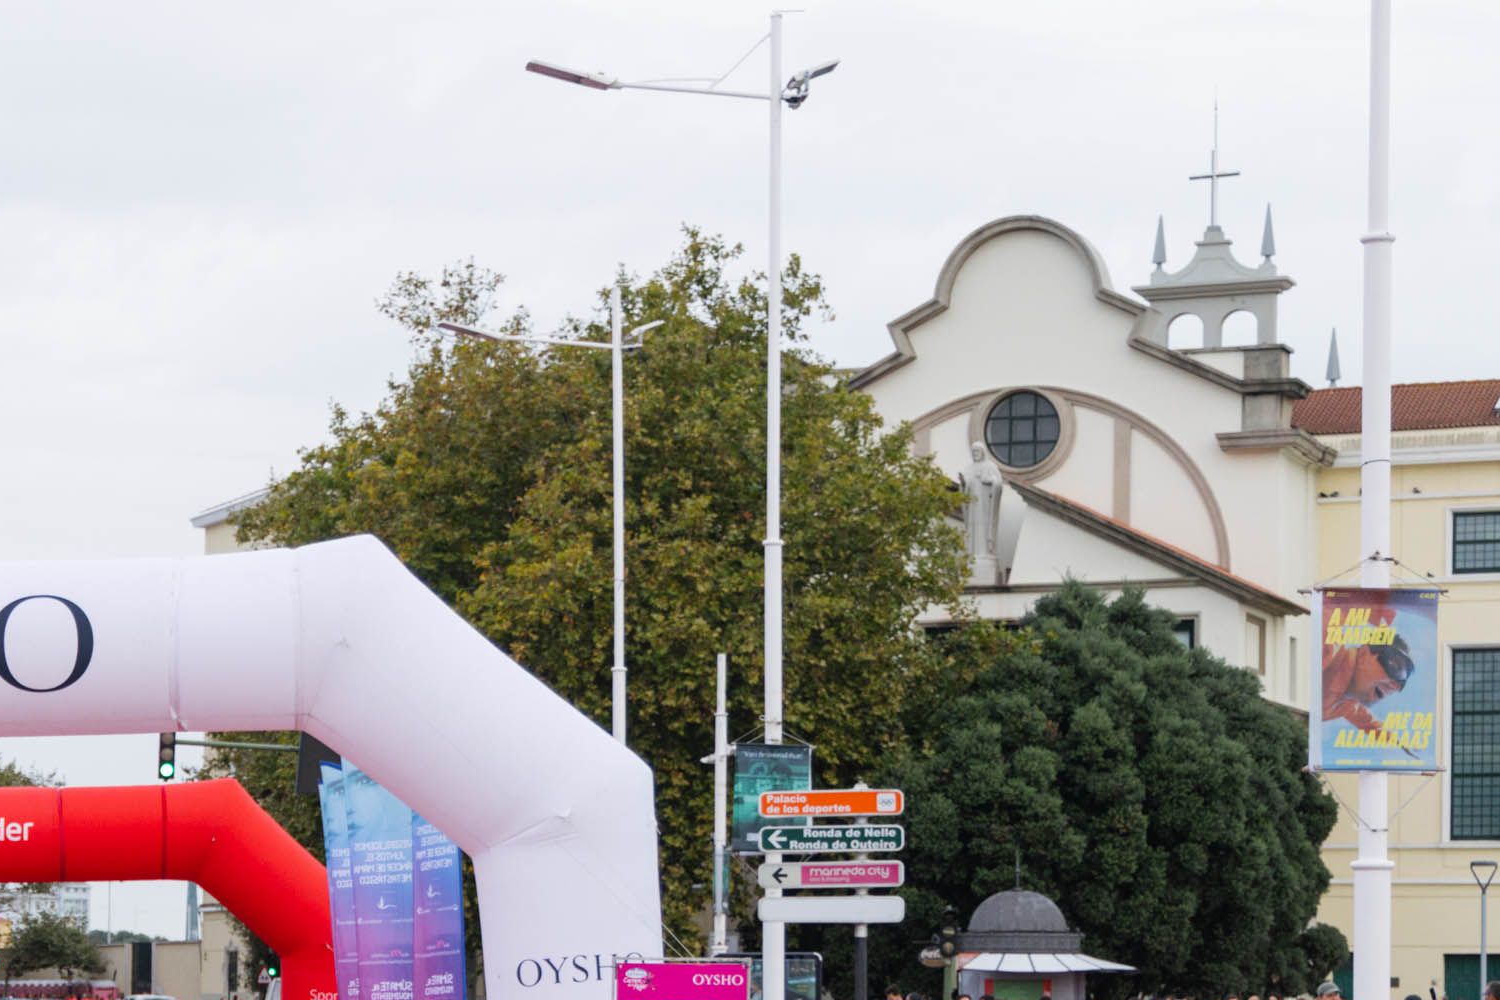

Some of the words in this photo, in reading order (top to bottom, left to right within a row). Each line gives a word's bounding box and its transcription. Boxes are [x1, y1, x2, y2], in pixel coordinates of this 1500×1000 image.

[1328, 608, 1342, 626] A
[1383, 712, 1411, 730] ME
[1412, 712, 1433, 730] DA
[766, 793, 807, 804] Palacio
[766, 804, 780, 814] de
[783, 803, 799, 813] los
[802, 803, 851, 815] deportes
[803, 829, 842, 838] Ronda
[845, 828, 861, 838] de
[864, 828, 896, 838] Nelle
[789, 840, 828, 849] Ronda
[831, 840, 847, 849] de
[850, 839, 896, 850] Outeiro
[809, 867, 866, 877] marineda
[867, 866, 890, 879] city
[692, 973, 745, 987] OYSHO
